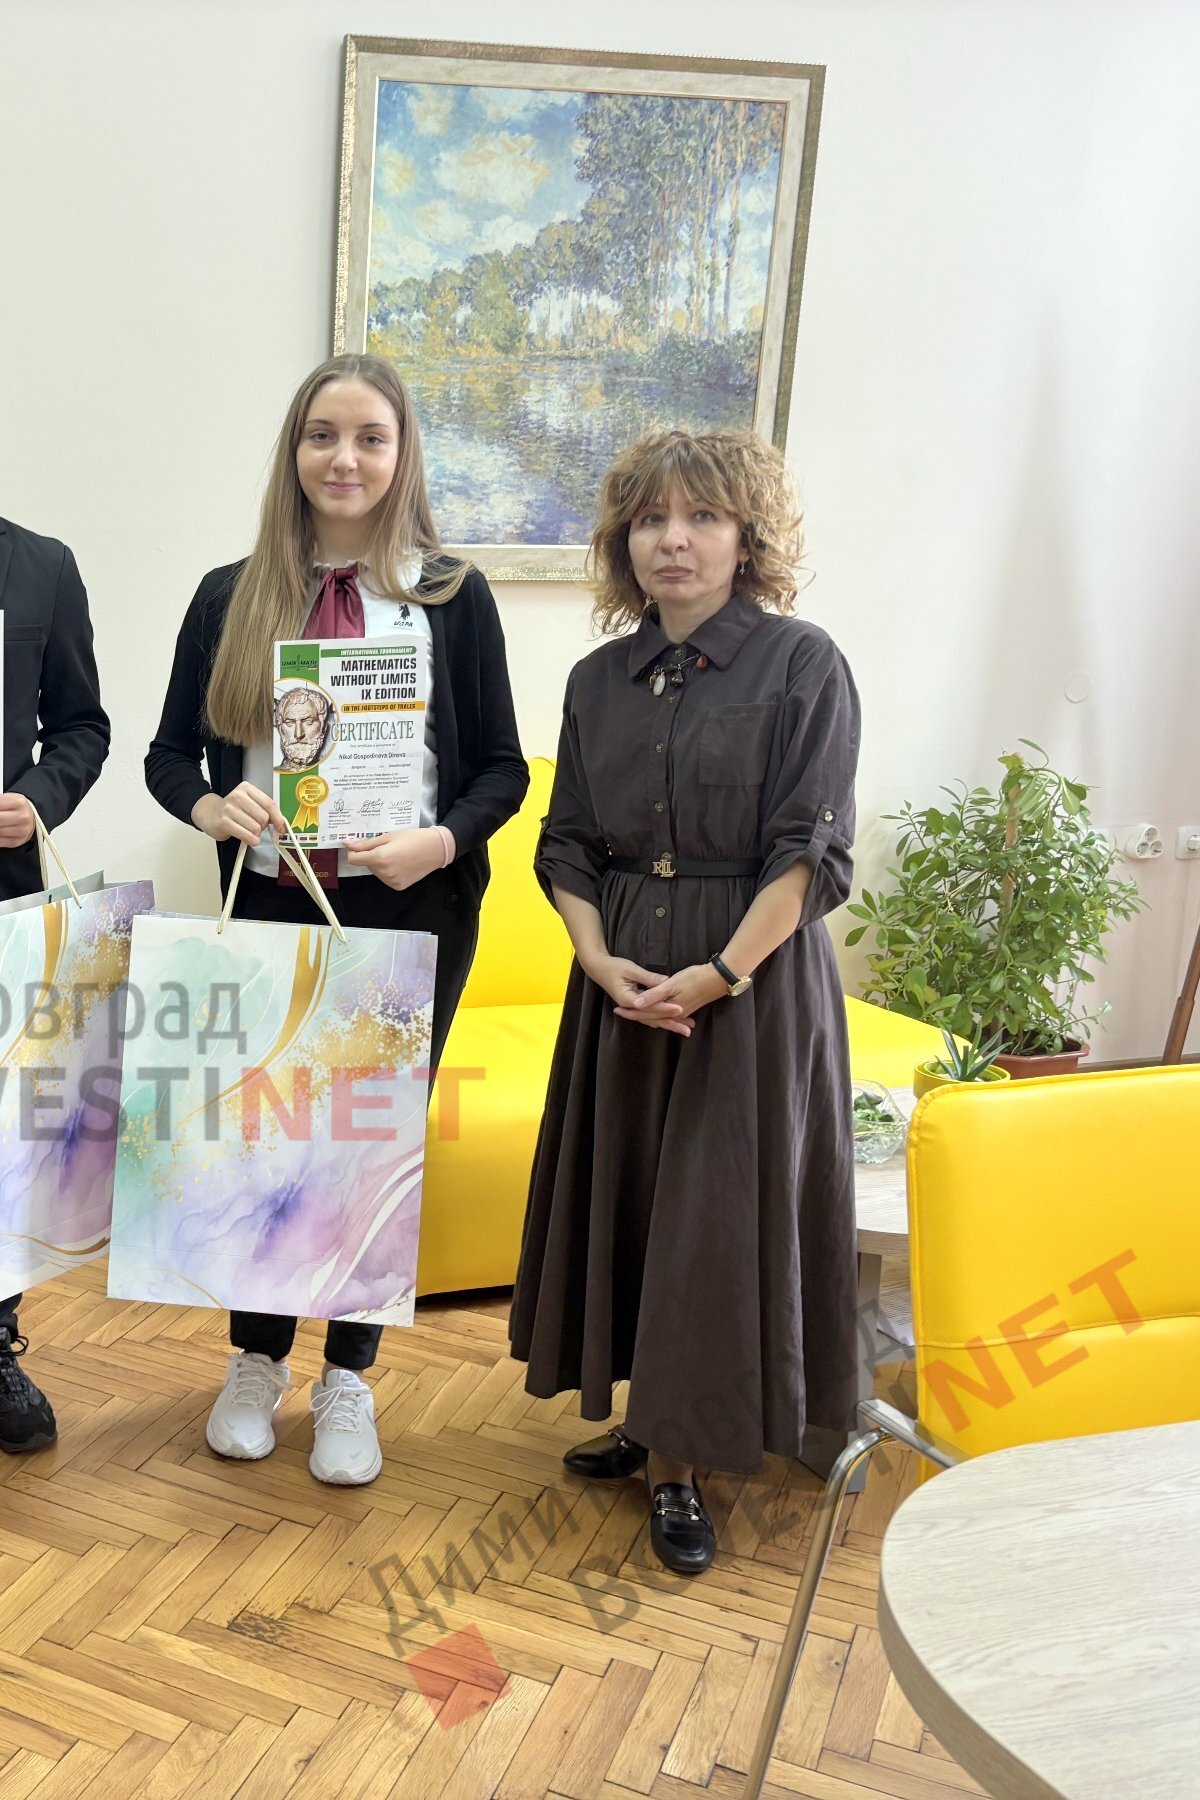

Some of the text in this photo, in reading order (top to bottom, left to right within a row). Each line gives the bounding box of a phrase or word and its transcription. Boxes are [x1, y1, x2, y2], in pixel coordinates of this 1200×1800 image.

[341, 658, 417, 672] MATHEMATICS
[330, 673, 416, 687] WITHOUT LIMITS
[361, 687, 416, 700] IX EDITION
[330, 720, 414, 742] CERTIFICATE
